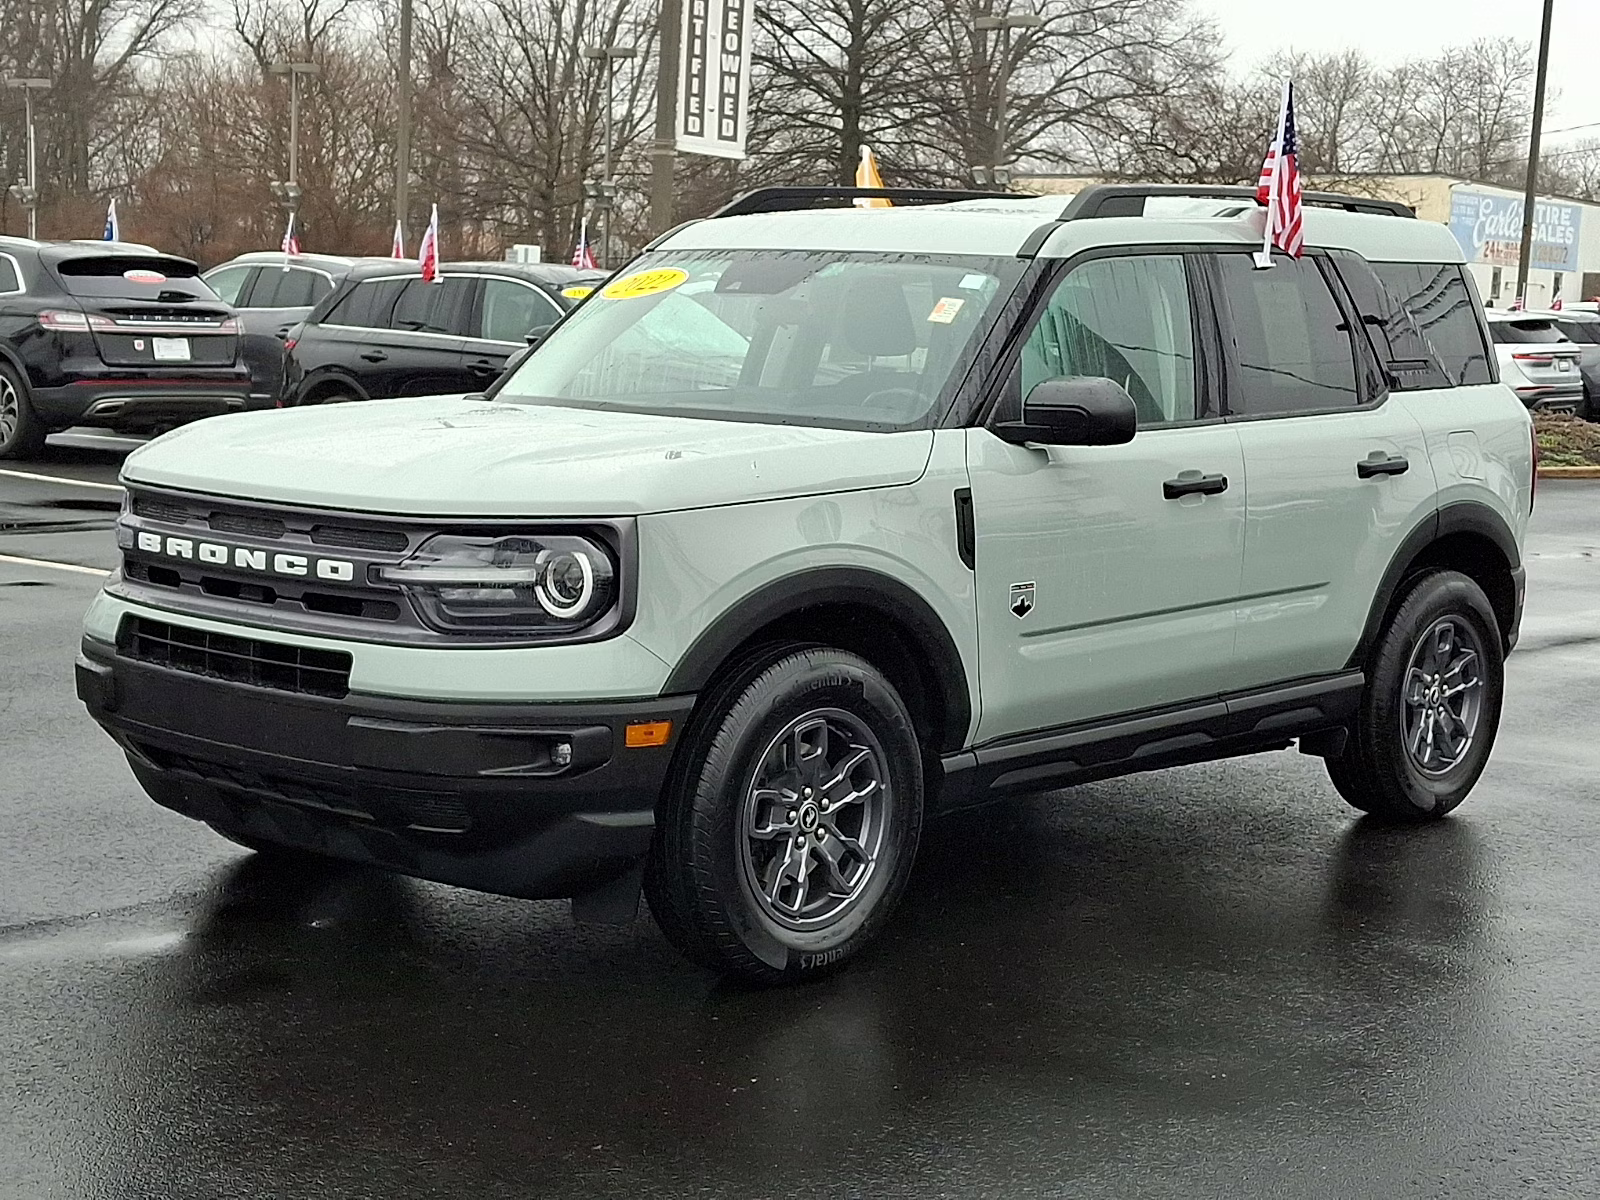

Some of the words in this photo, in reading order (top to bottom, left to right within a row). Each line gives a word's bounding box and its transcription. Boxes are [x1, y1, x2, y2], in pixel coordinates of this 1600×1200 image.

[1536, 204, 1572, 226] TIRE
[1531, 222, 1575, 244] SALES
[610, 272, 678, 295] 2022
[137, 531, 354, 582] BRONCO
